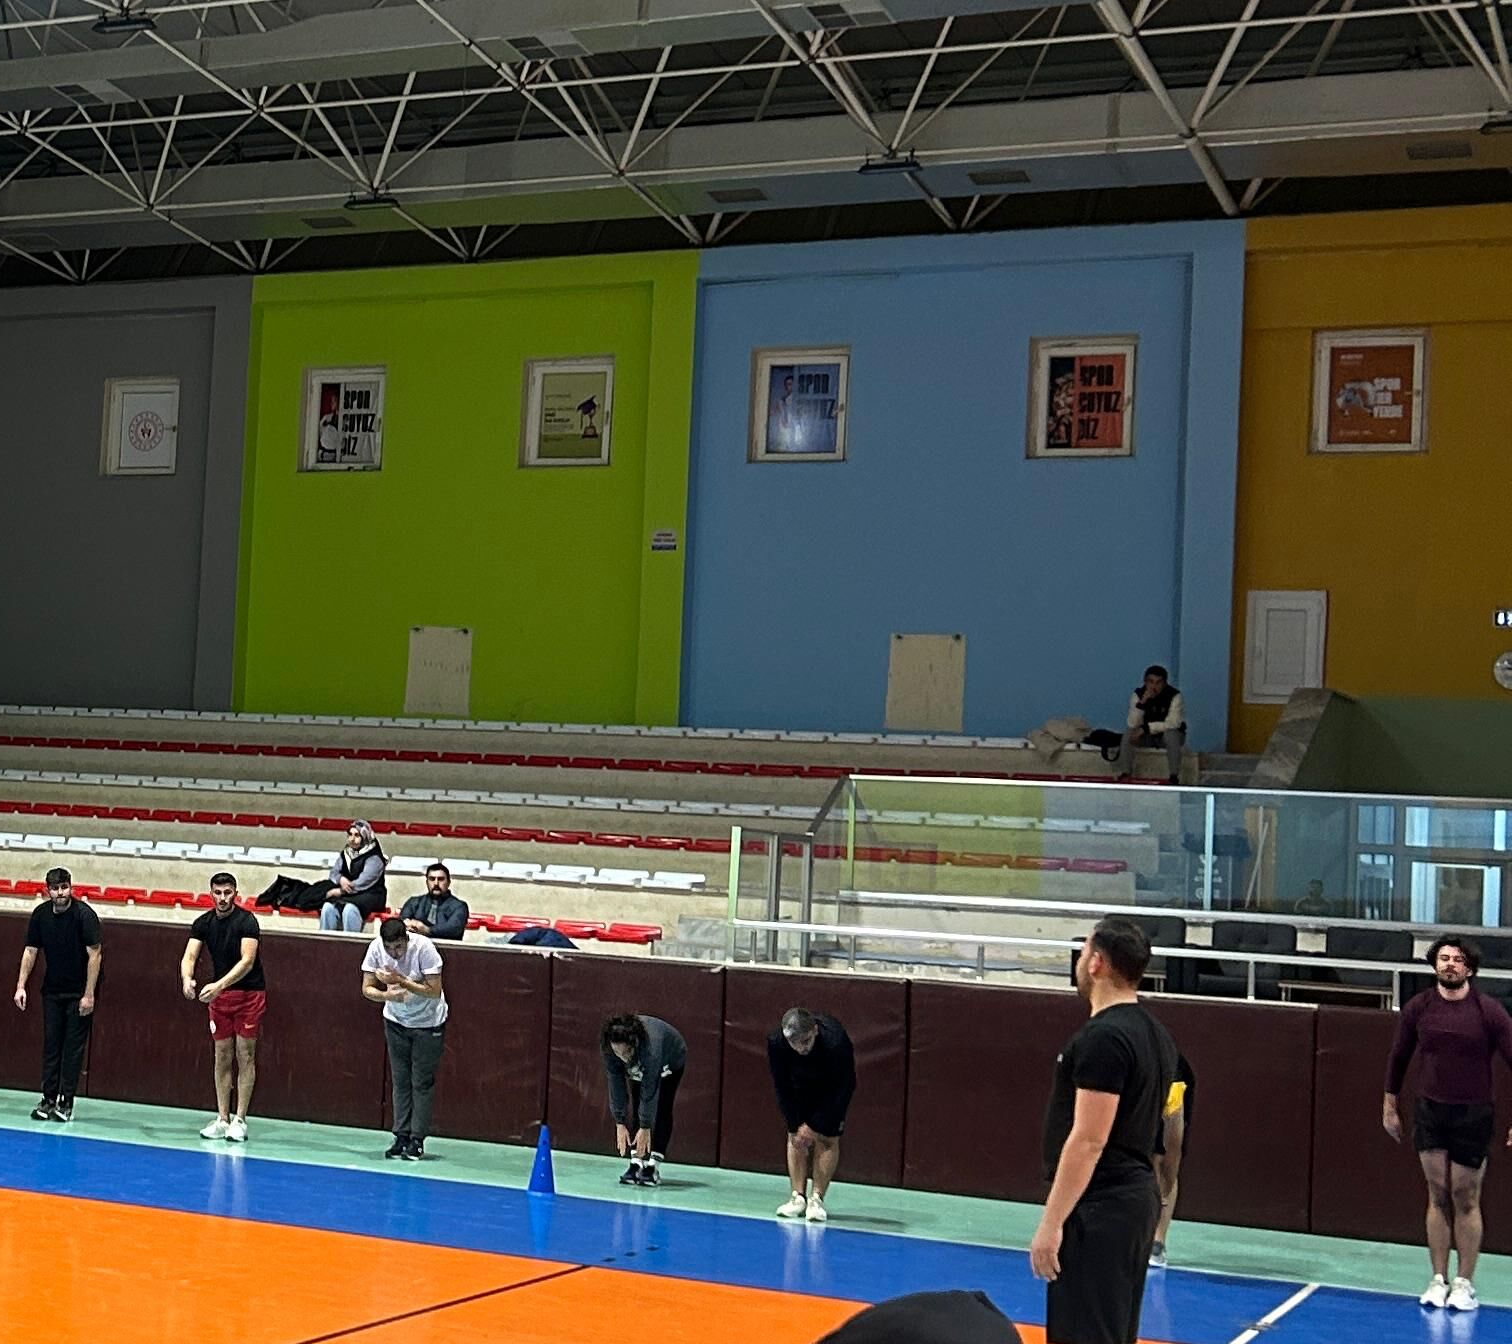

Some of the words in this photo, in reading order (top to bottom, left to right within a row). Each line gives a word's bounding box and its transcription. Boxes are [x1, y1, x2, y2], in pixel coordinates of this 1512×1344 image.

[798, 373, 829, 394] SPOR
[1080, 365, 1114, 387] SPOR
[344, 390, 371, 409] SPOR
[1079, 391, 1121, 413] CUYUZ
[342, 413, 376, 432] CUYUZ
